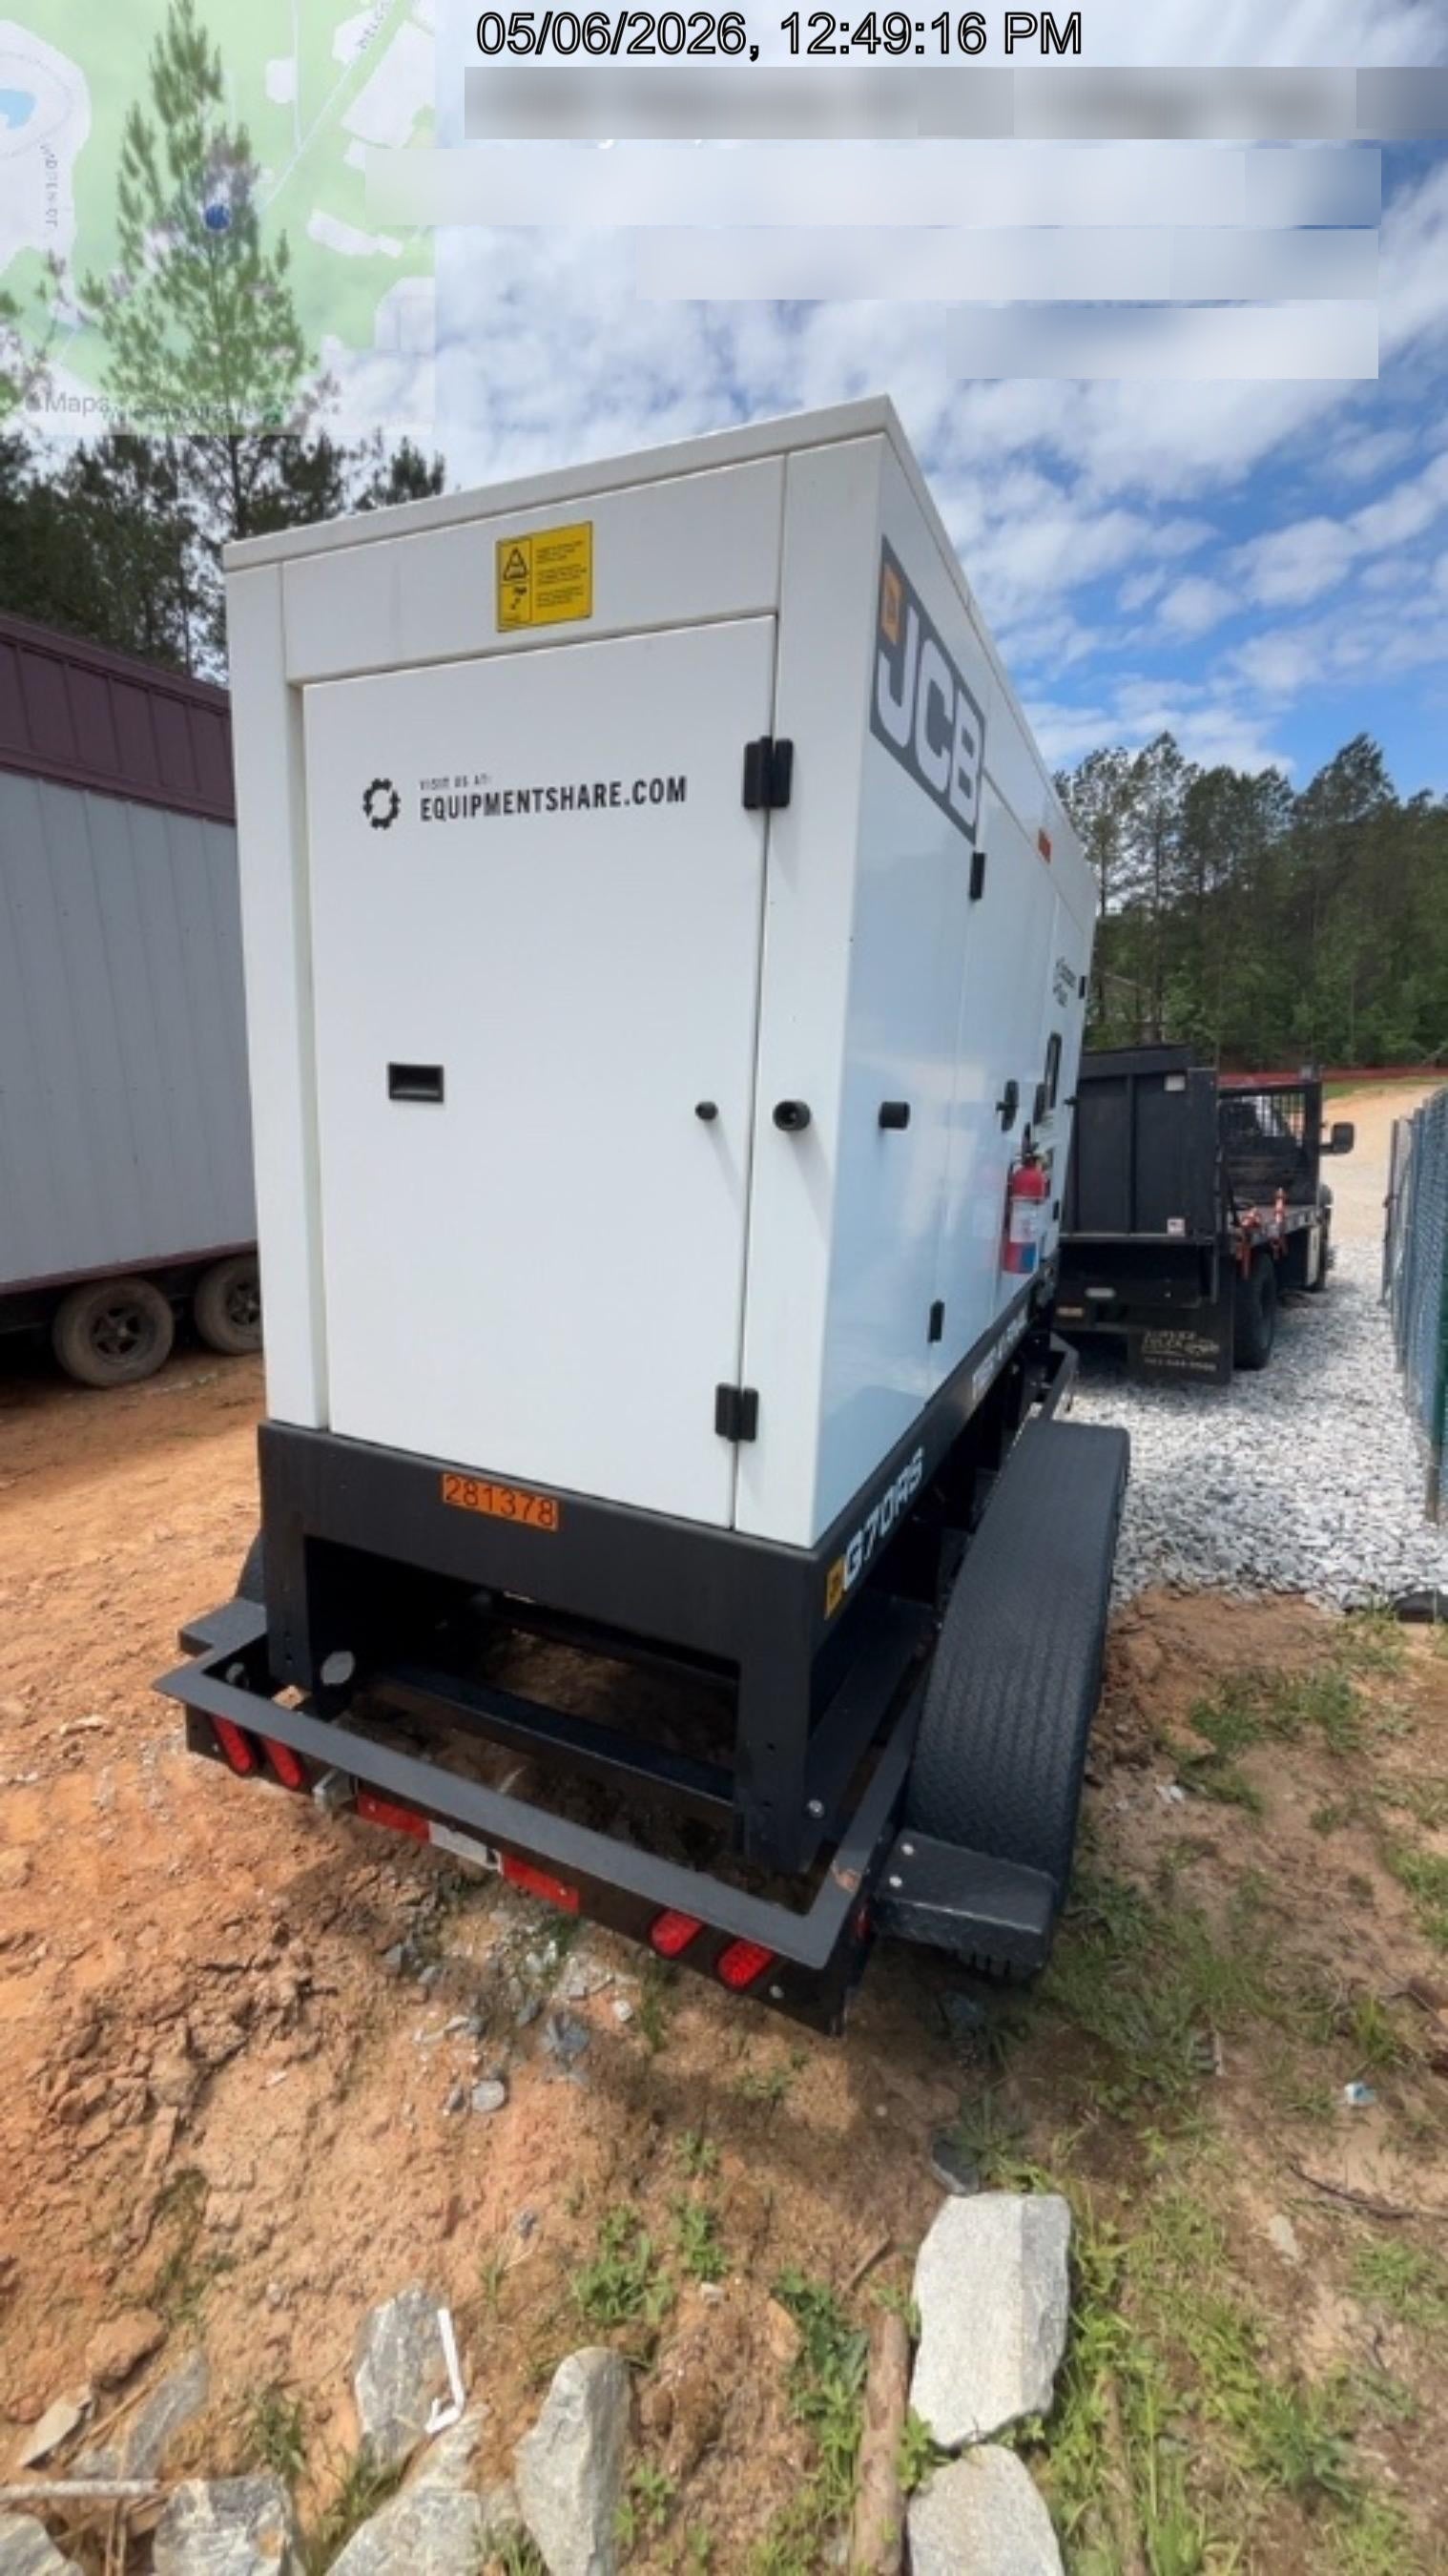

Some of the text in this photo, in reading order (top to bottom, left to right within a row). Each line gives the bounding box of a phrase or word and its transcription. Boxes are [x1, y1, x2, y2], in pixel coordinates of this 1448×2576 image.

[877, 604, 983, 830] JCB
[420, 776, 687, 822] EQUIPMENTSHARE.COM
[445, 1476, 554, 1527] 281378
[843, 1446, 924, 1591] G70RS
